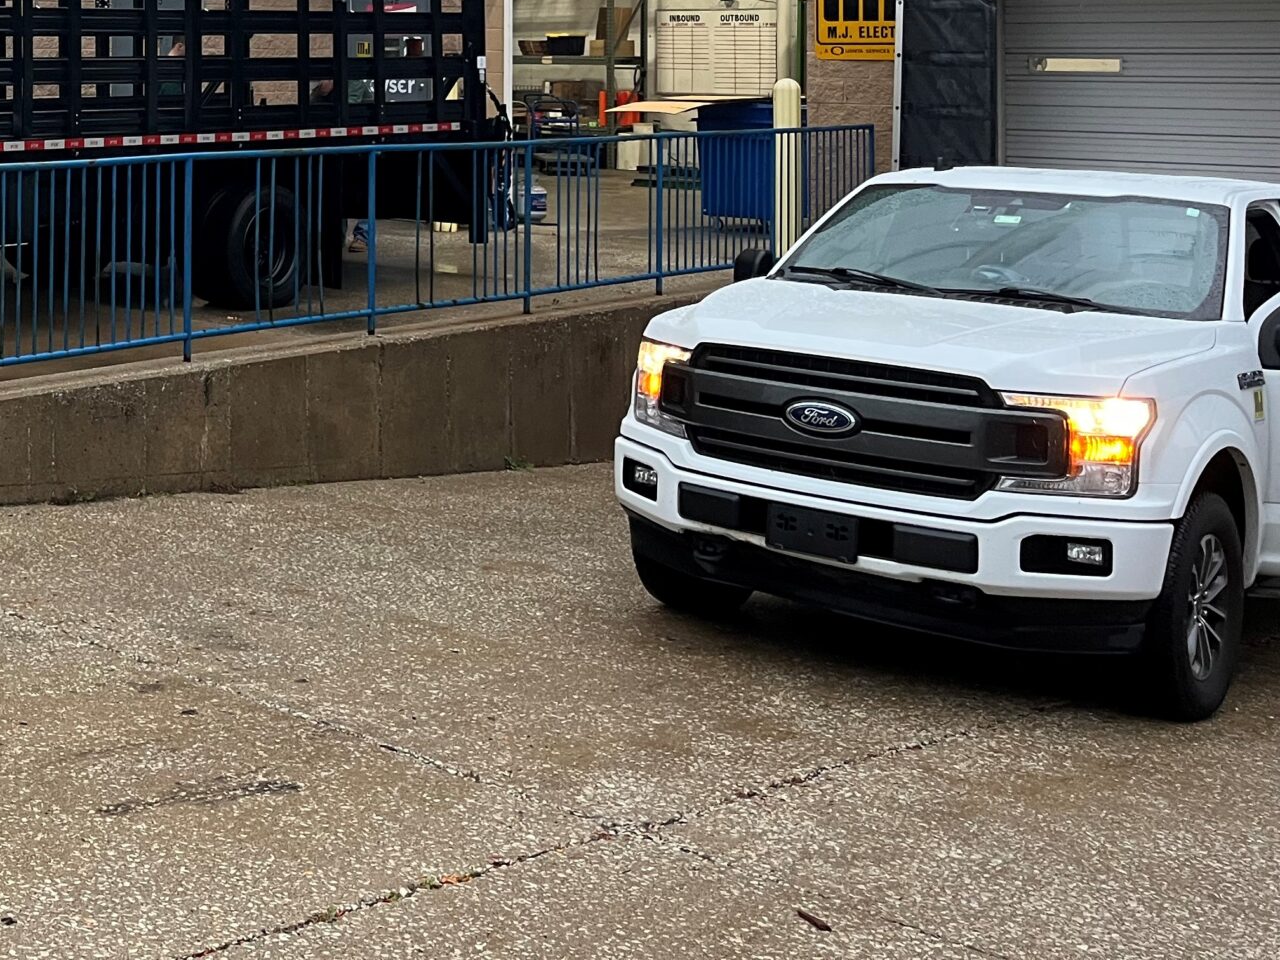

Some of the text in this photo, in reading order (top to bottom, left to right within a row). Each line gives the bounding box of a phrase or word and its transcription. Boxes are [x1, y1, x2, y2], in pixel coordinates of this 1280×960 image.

[669, 14, 701, 22] INBOUND
[720, 14, 760, 22] OUTBOUND
[827, 26, 895, 39] M.J. ELECT
[800, 407, 838, 427] Ford
